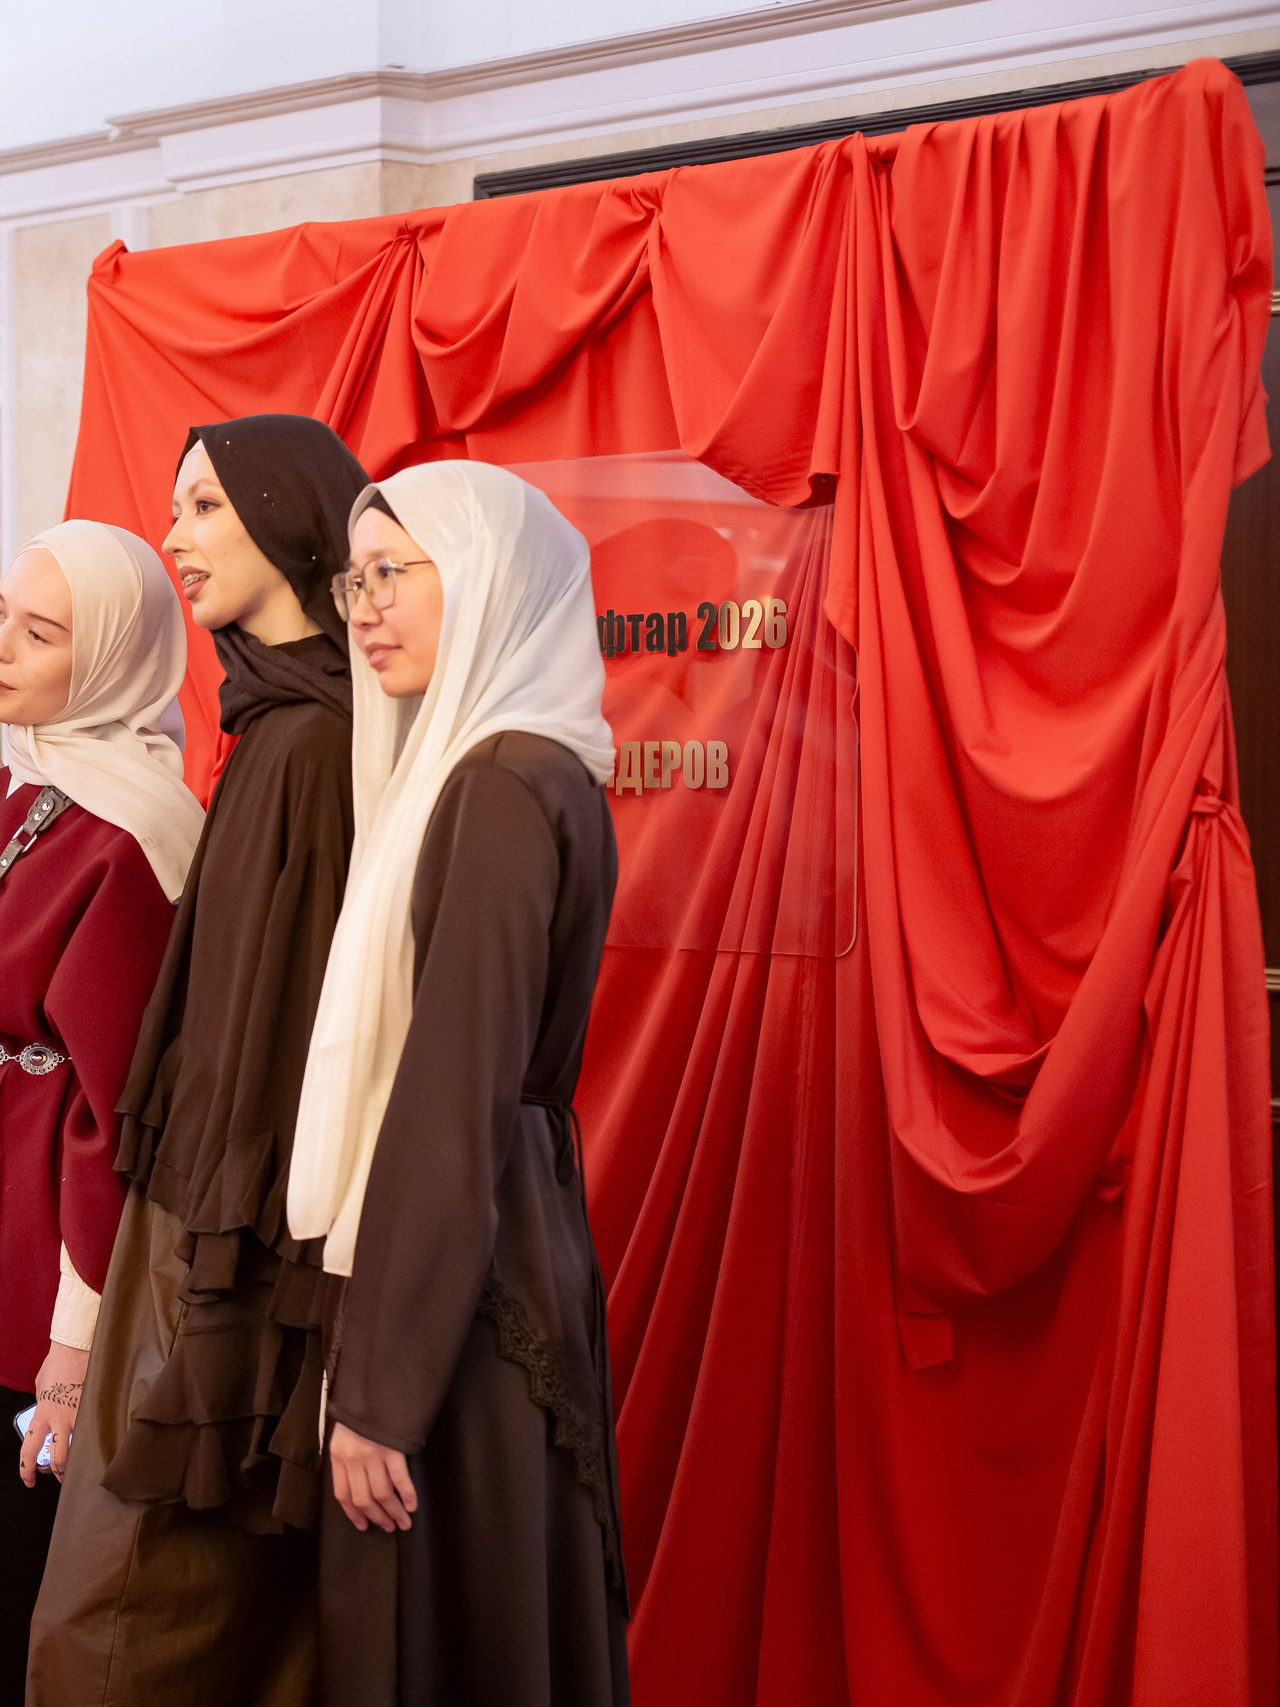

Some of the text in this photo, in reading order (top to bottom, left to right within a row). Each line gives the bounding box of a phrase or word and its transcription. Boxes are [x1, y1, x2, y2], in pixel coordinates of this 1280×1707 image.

[597, 599, 787, 658] фтар 2026
[607, 740, 729, 796] ДЕРОВ
